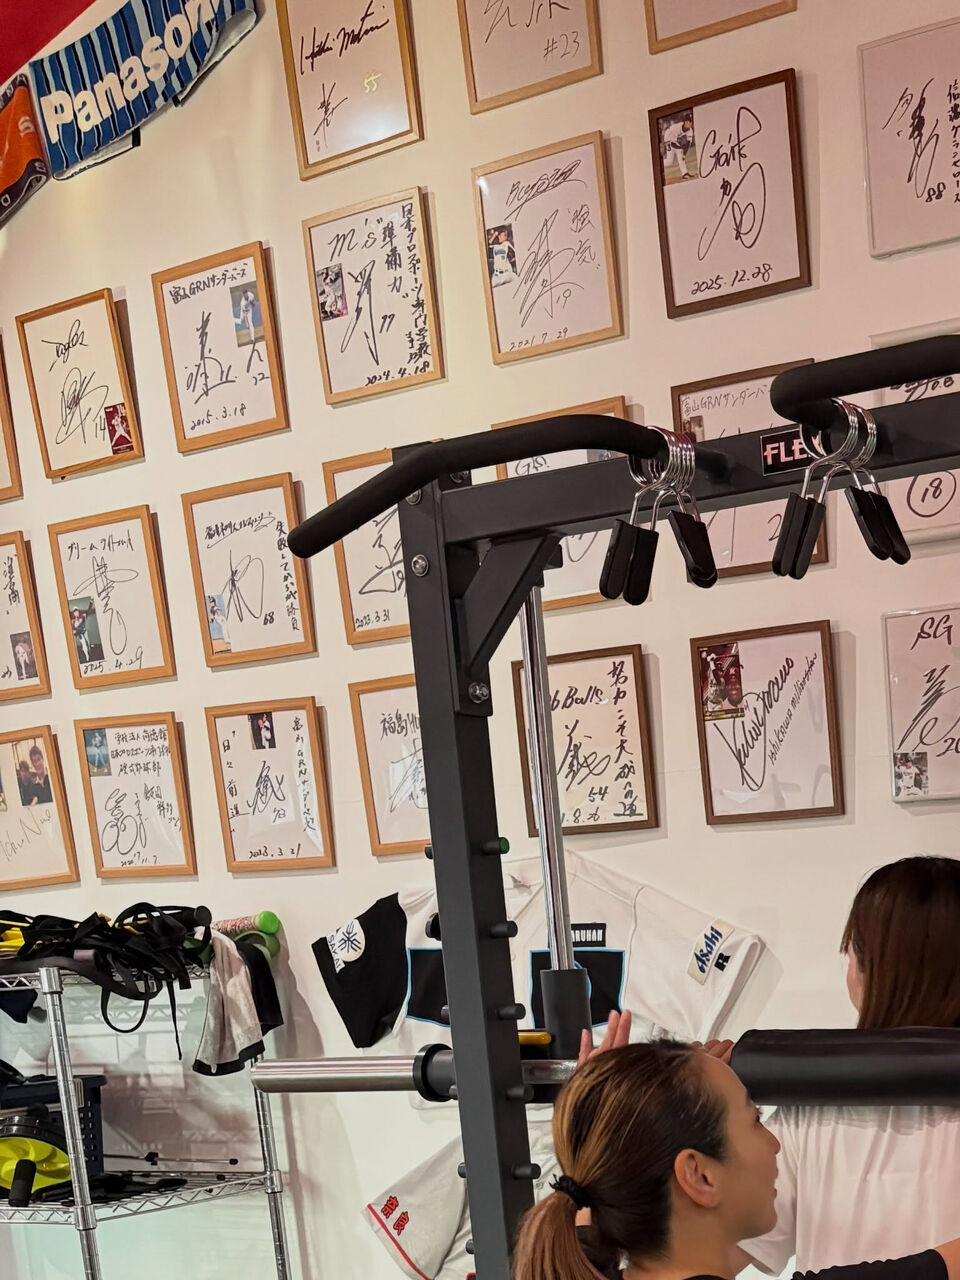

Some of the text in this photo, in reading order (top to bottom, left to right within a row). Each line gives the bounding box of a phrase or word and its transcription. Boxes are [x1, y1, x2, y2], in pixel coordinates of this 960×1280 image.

[925, 182, 946, 203] 88
[327, 934, 341, 968] SAKAI
[694, 925, 723, 974] Asahi
